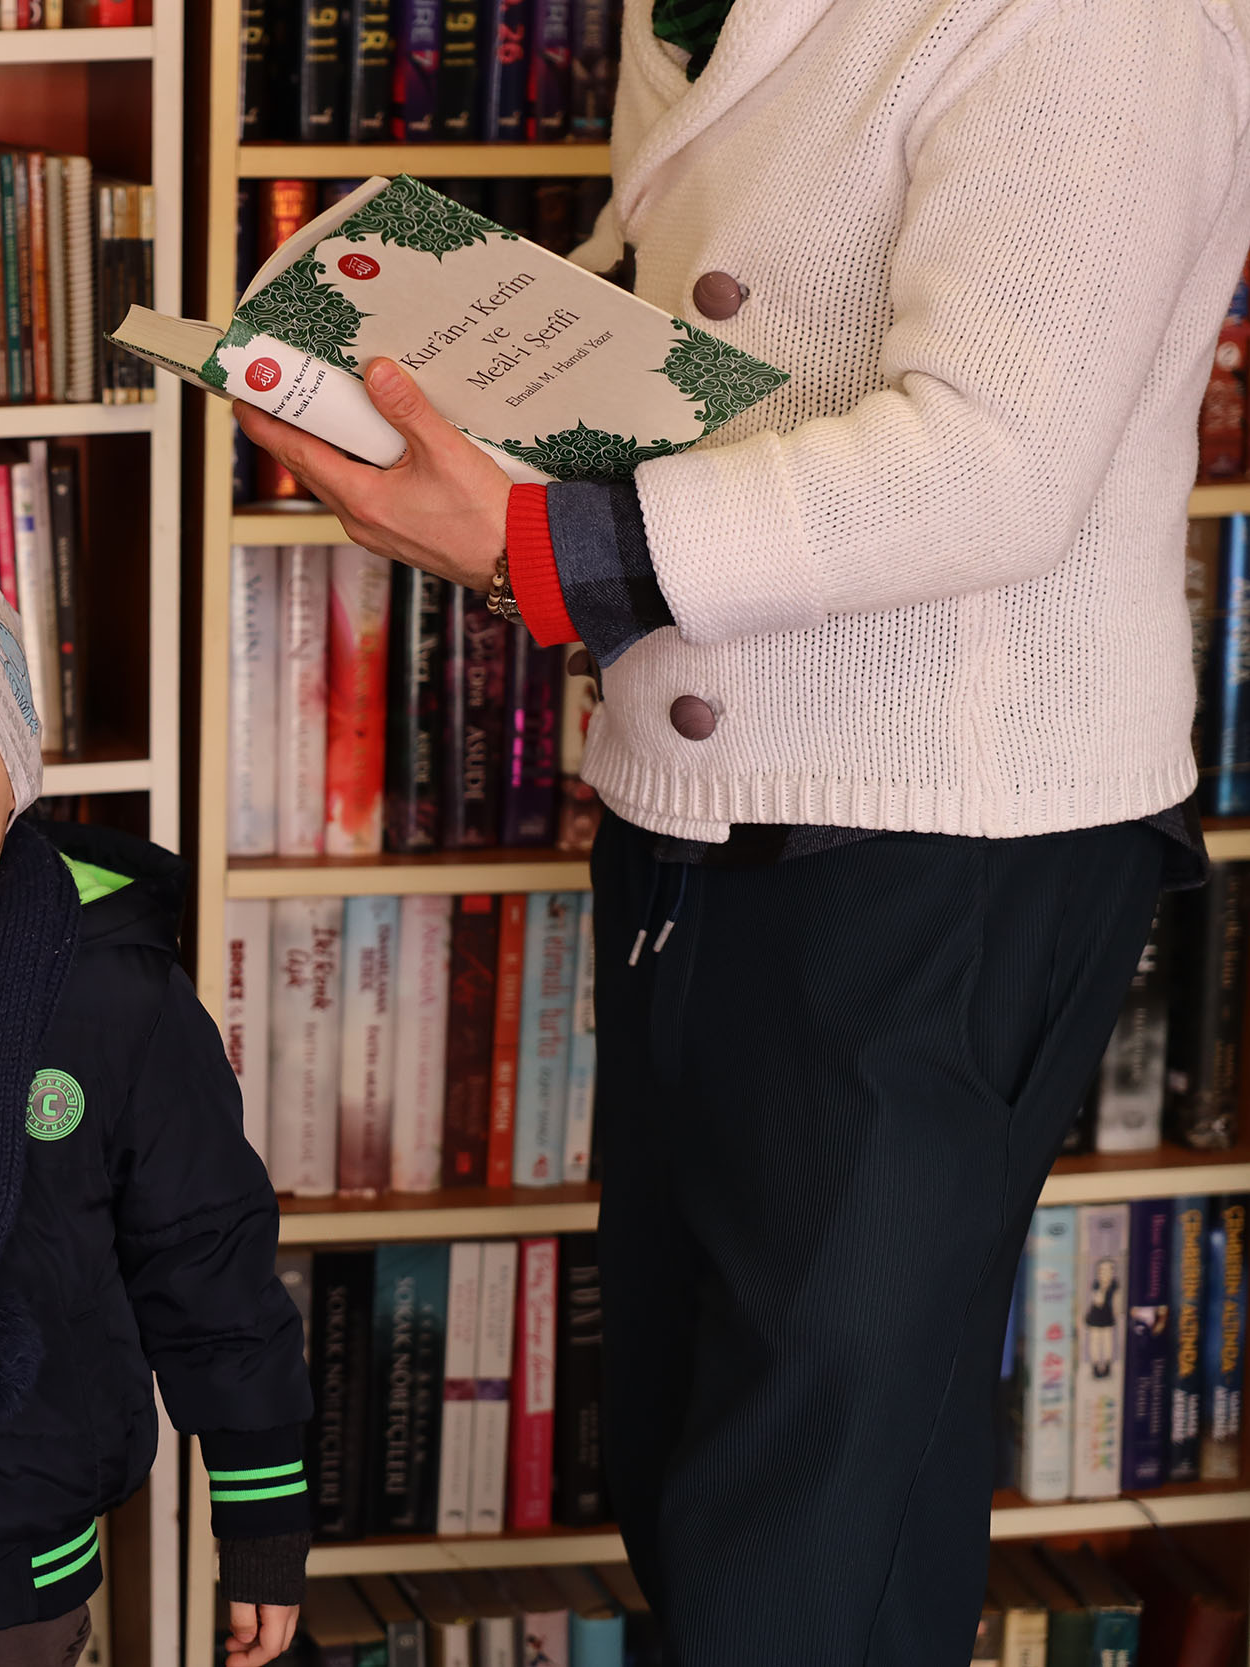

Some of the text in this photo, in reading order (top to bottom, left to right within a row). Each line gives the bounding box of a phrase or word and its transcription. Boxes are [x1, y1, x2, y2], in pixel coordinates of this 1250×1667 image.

[469, 271, 537, 318] Kerîm
[465, 308, 582, 391] Meâl-i Şerîfi
[481, 325, 511, 346] ve
[505, 330, 614, 408] Elmalılı M. Hamdi Yazır
[298, 386, 308, 398] ve
[42, 1094, 59, 1117] C
[325, 1285, 348, 1357] SOKAK
[393, 1276, 415, 1347] SOKAK
[1177, 1303, 1198, 1377] ALTINDA
[1220, 1298, 1240, 1373] ALTINDA
